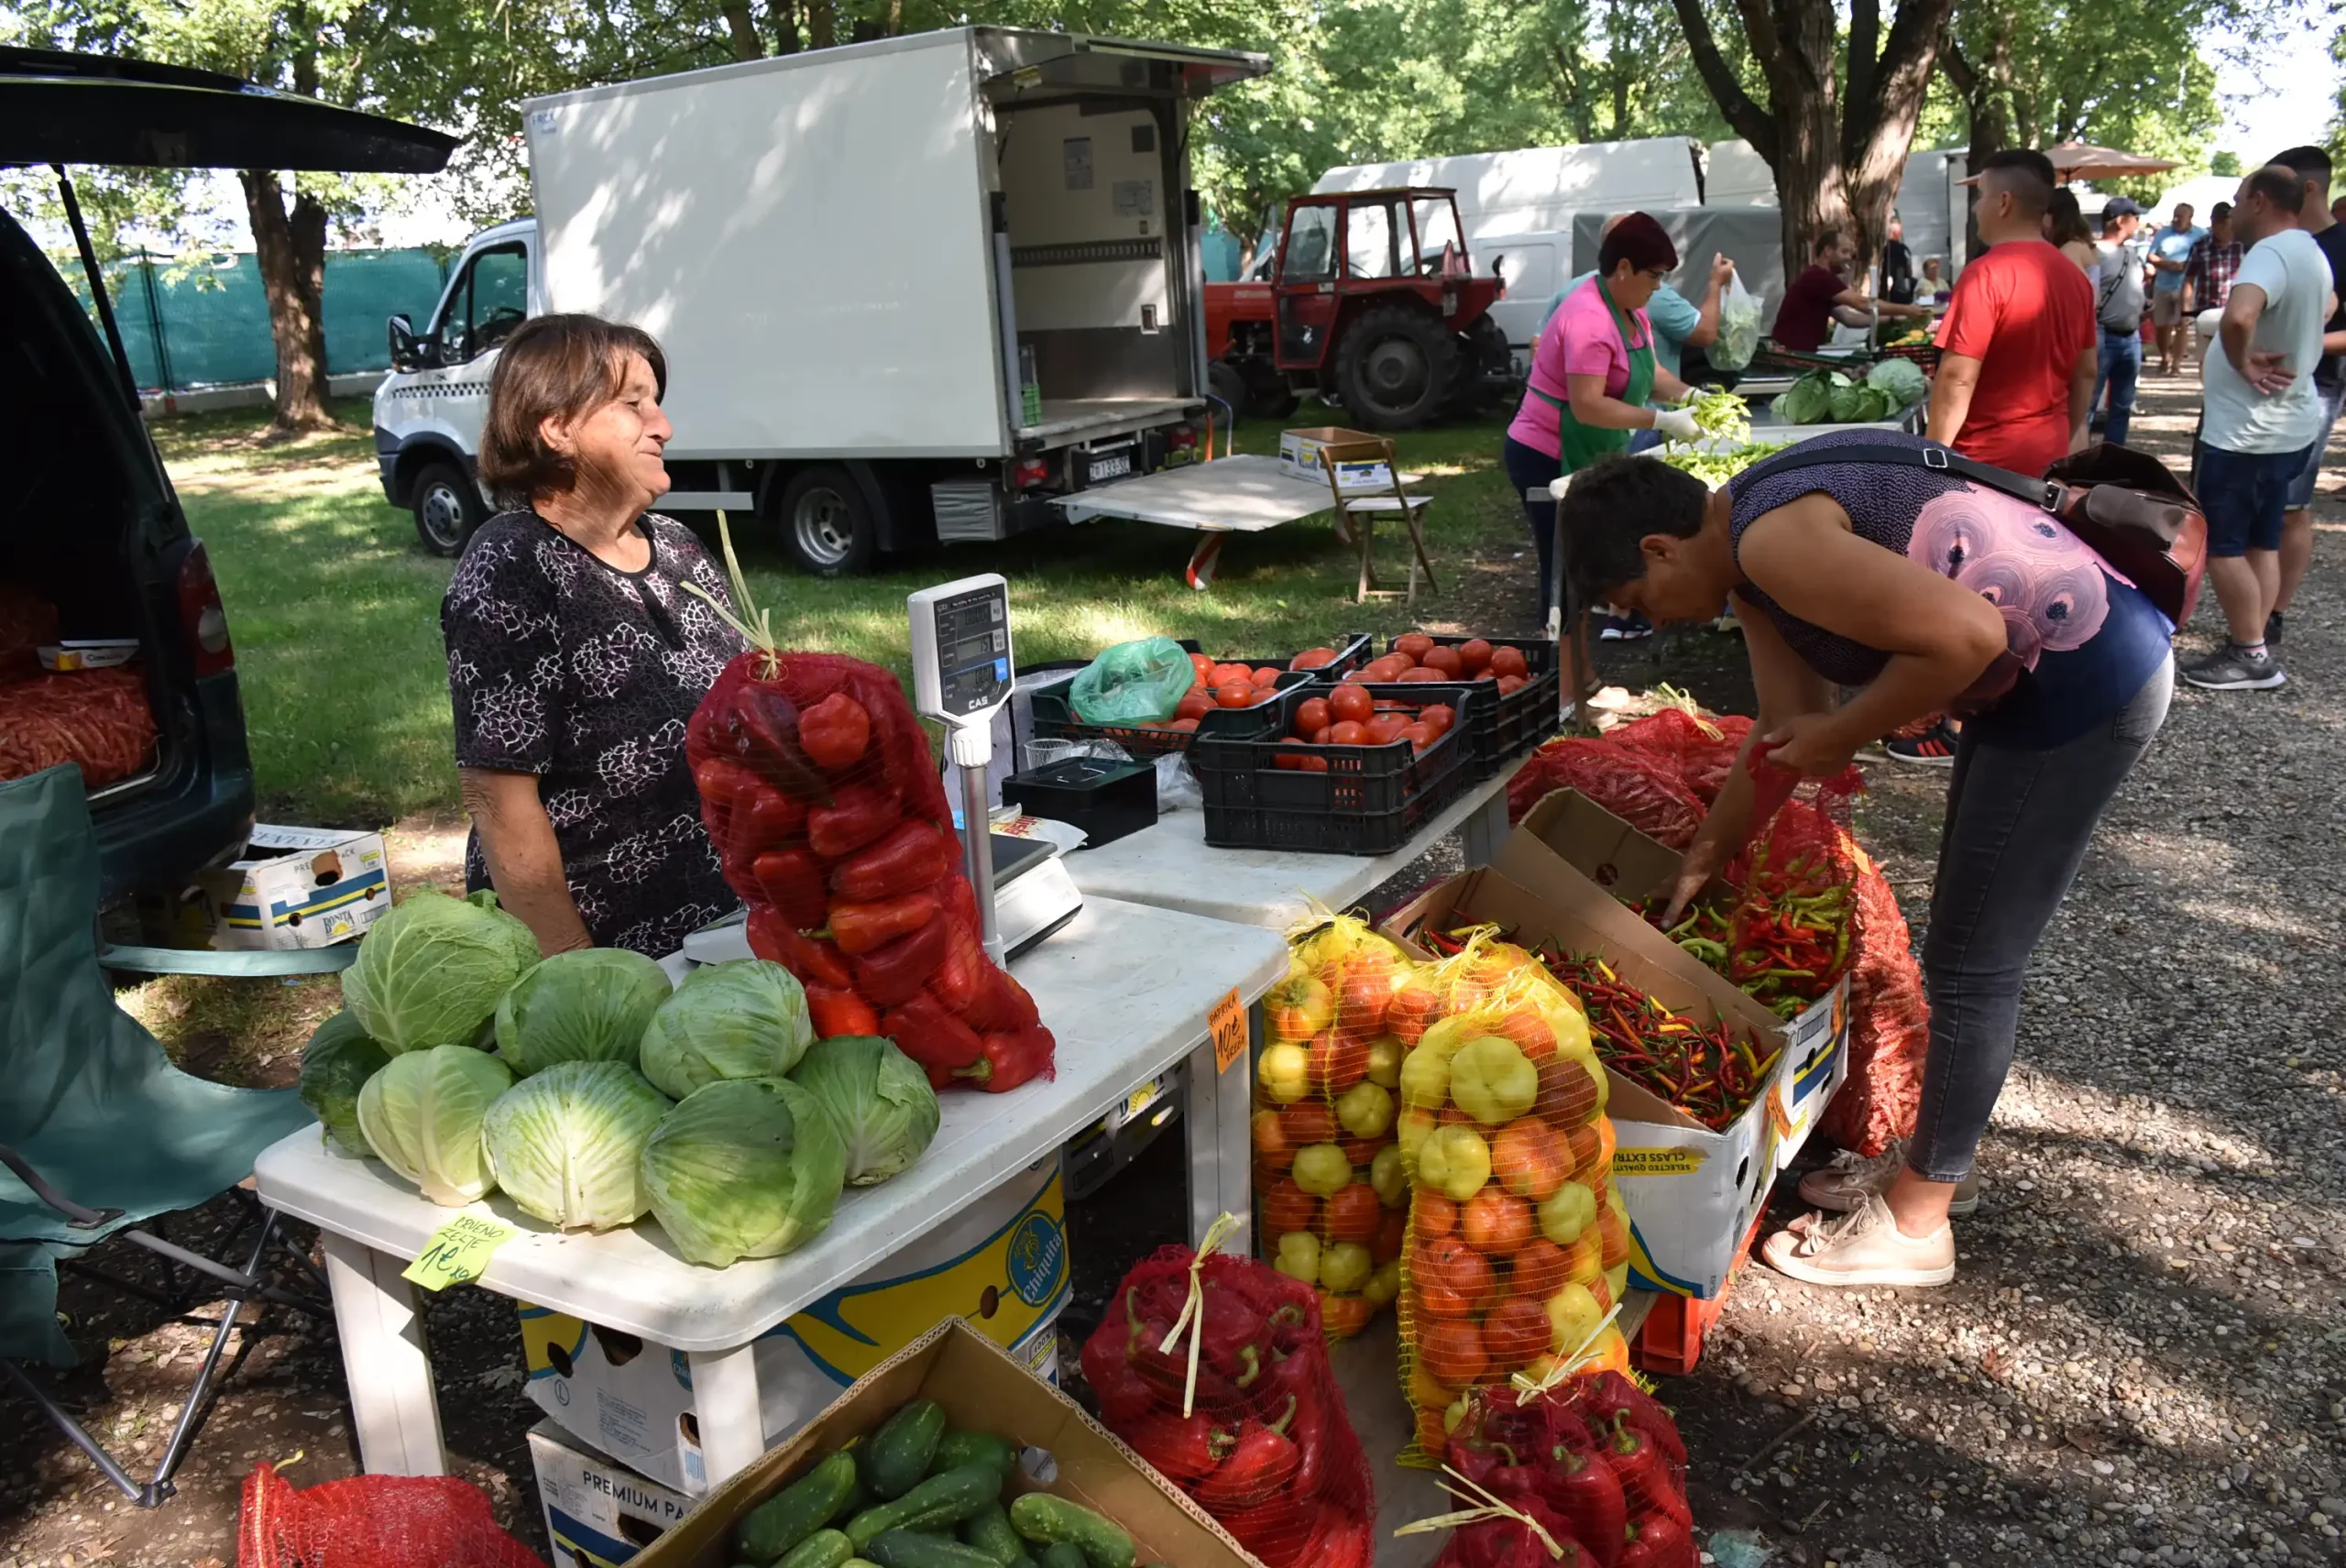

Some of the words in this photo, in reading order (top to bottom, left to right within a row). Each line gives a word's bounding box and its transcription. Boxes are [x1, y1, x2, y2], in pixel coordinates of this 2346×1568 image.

[969, 696, 988, 710] CAS
[323, 910, 356, 934] BONITA
[1209, 993, 1237, 1027] PAPRIKA
[1217, 1014, 1240, 1058] 10€
[1649, 1153, 1685, 1162] CLASS
[421, 1242, 460, 1274] 1€
[1022, 1232, 1063, 1304] Chiquita
[583, 1470, 658, 1513] PREMIUM
[664, 1502, 692, 1521] PA
